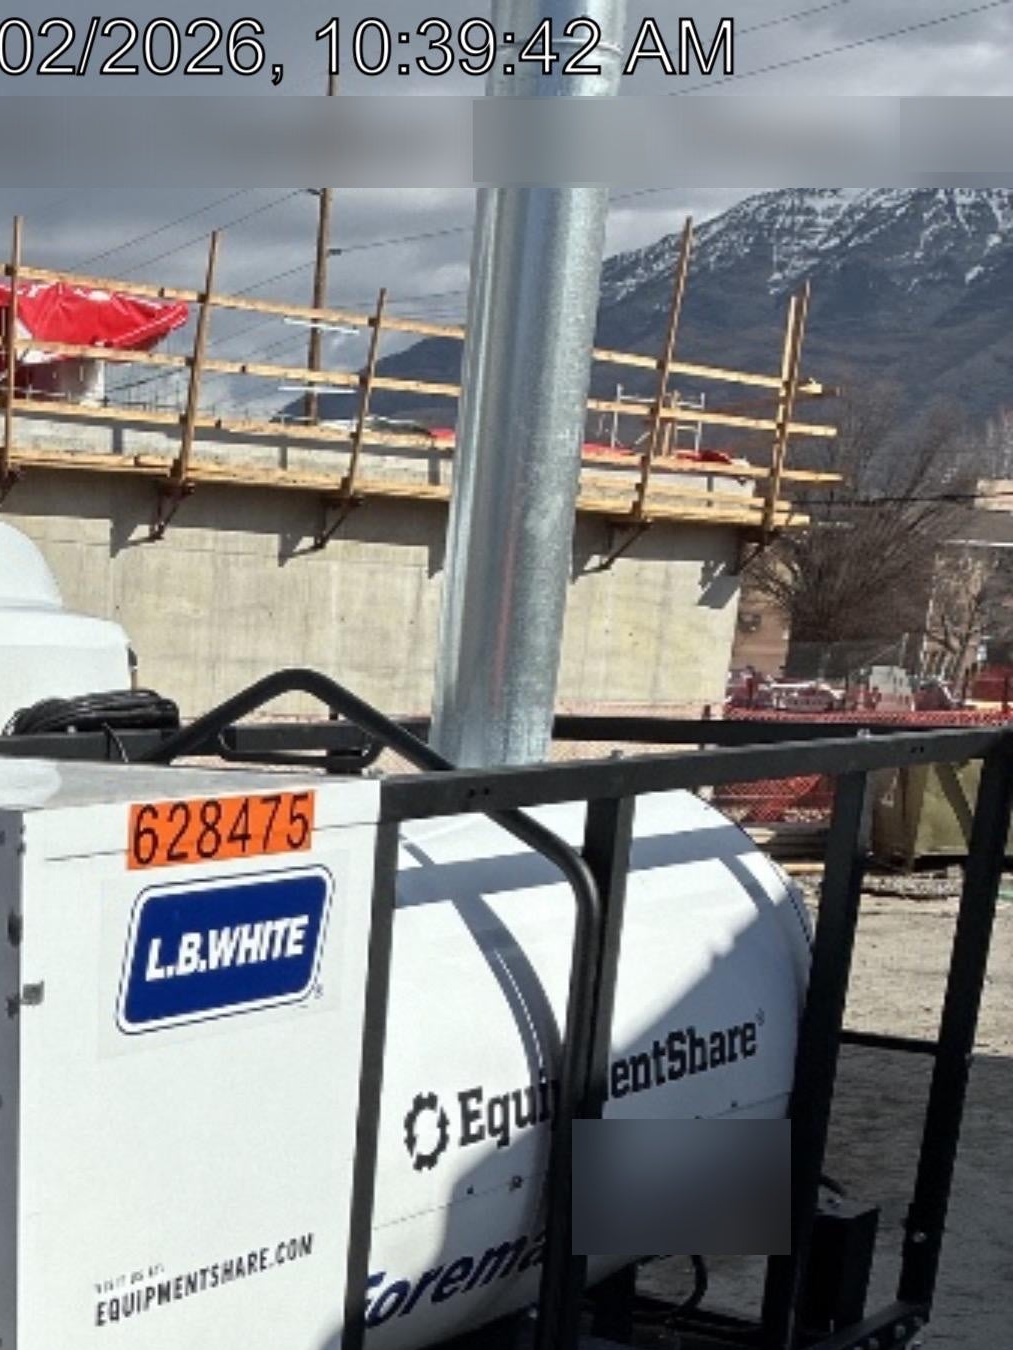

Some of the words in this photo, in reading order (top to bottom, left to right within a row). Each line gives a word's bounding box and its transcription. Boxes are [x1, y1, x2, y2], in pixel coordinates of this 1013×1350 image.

[133, 794, 310, 865] 628475
[145, 914, 309, 982] L.B.WHITE
[95, 1232, 313, 1327] EQUIPMENTSHARE.COM
